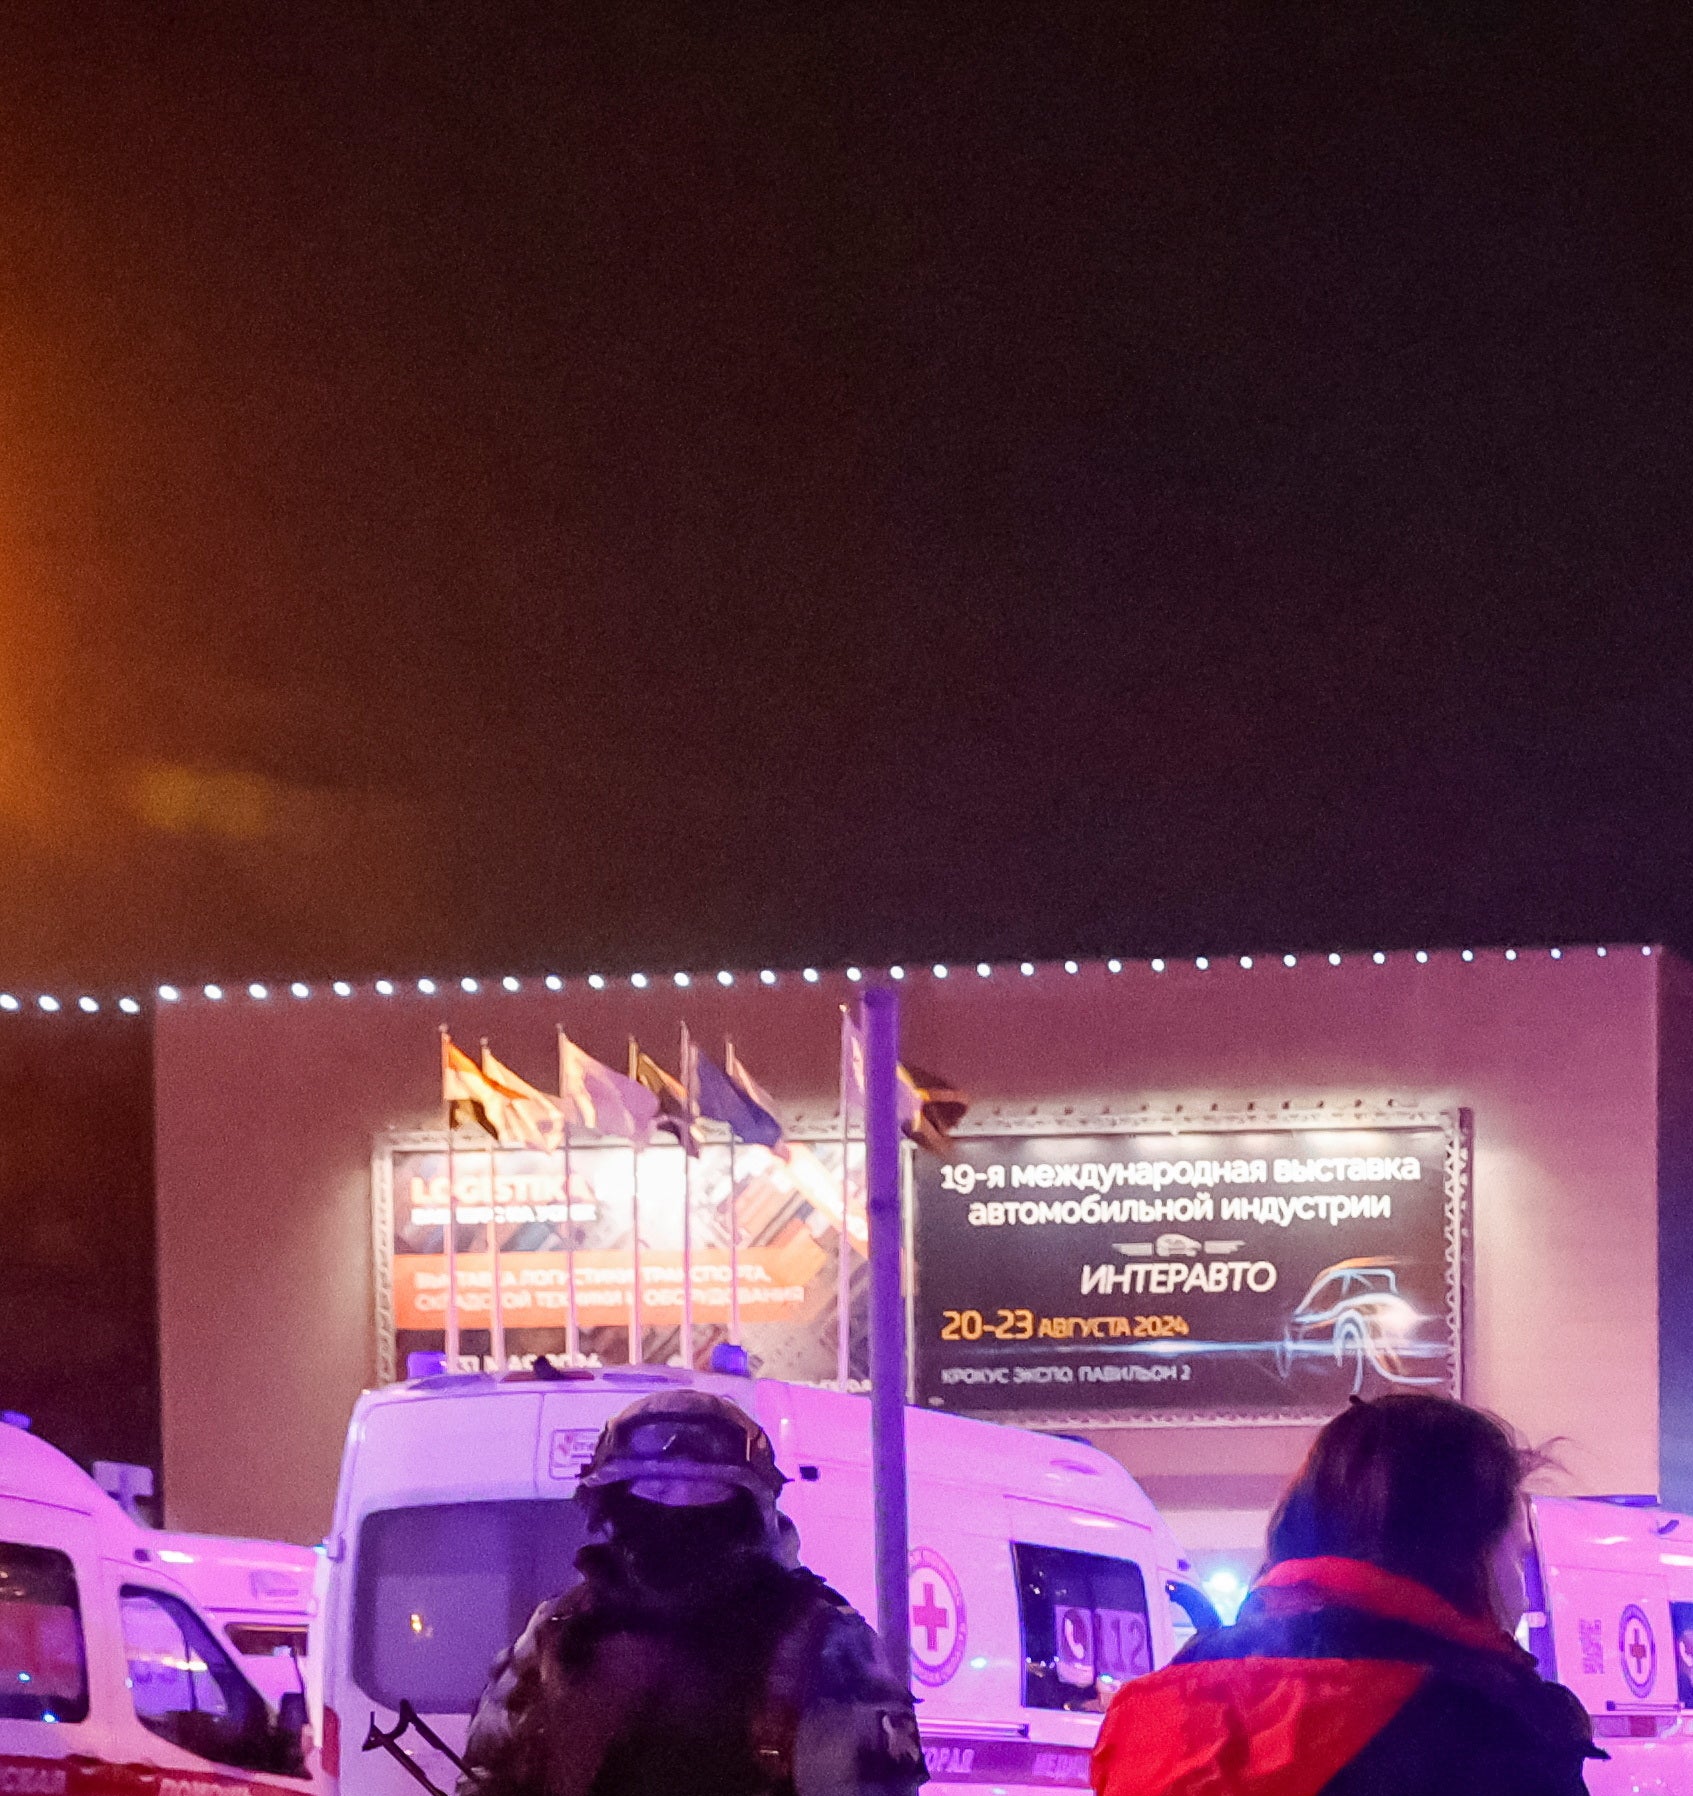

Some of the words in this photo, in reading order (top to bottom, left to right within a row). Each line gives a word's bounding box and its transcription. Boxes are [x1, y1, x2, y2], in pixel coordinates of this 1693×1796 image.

[941, 1164, 1005, 1193] 19-я
[1011, 1156, 1267, 1193] международная
[1273, 1155, 1421, 1185] выставка
[968, 1192, 1214, 1227] автомобильной
[1221, 1192, 1391, 1227] индустрии
[1080, 1259, 1277, 1295] ИНТЕРАВТО
[940, 1309, 1034, 1341] 20-23
[1037, 1316, 1131, 1339] АВГУСТА
[1132, 1315, 1190, 1337] 2024
[940, 1366, 1010, 1385] КРОКУС
[1077, 1364, 1177, 1383] ПАВИЛЬОН
